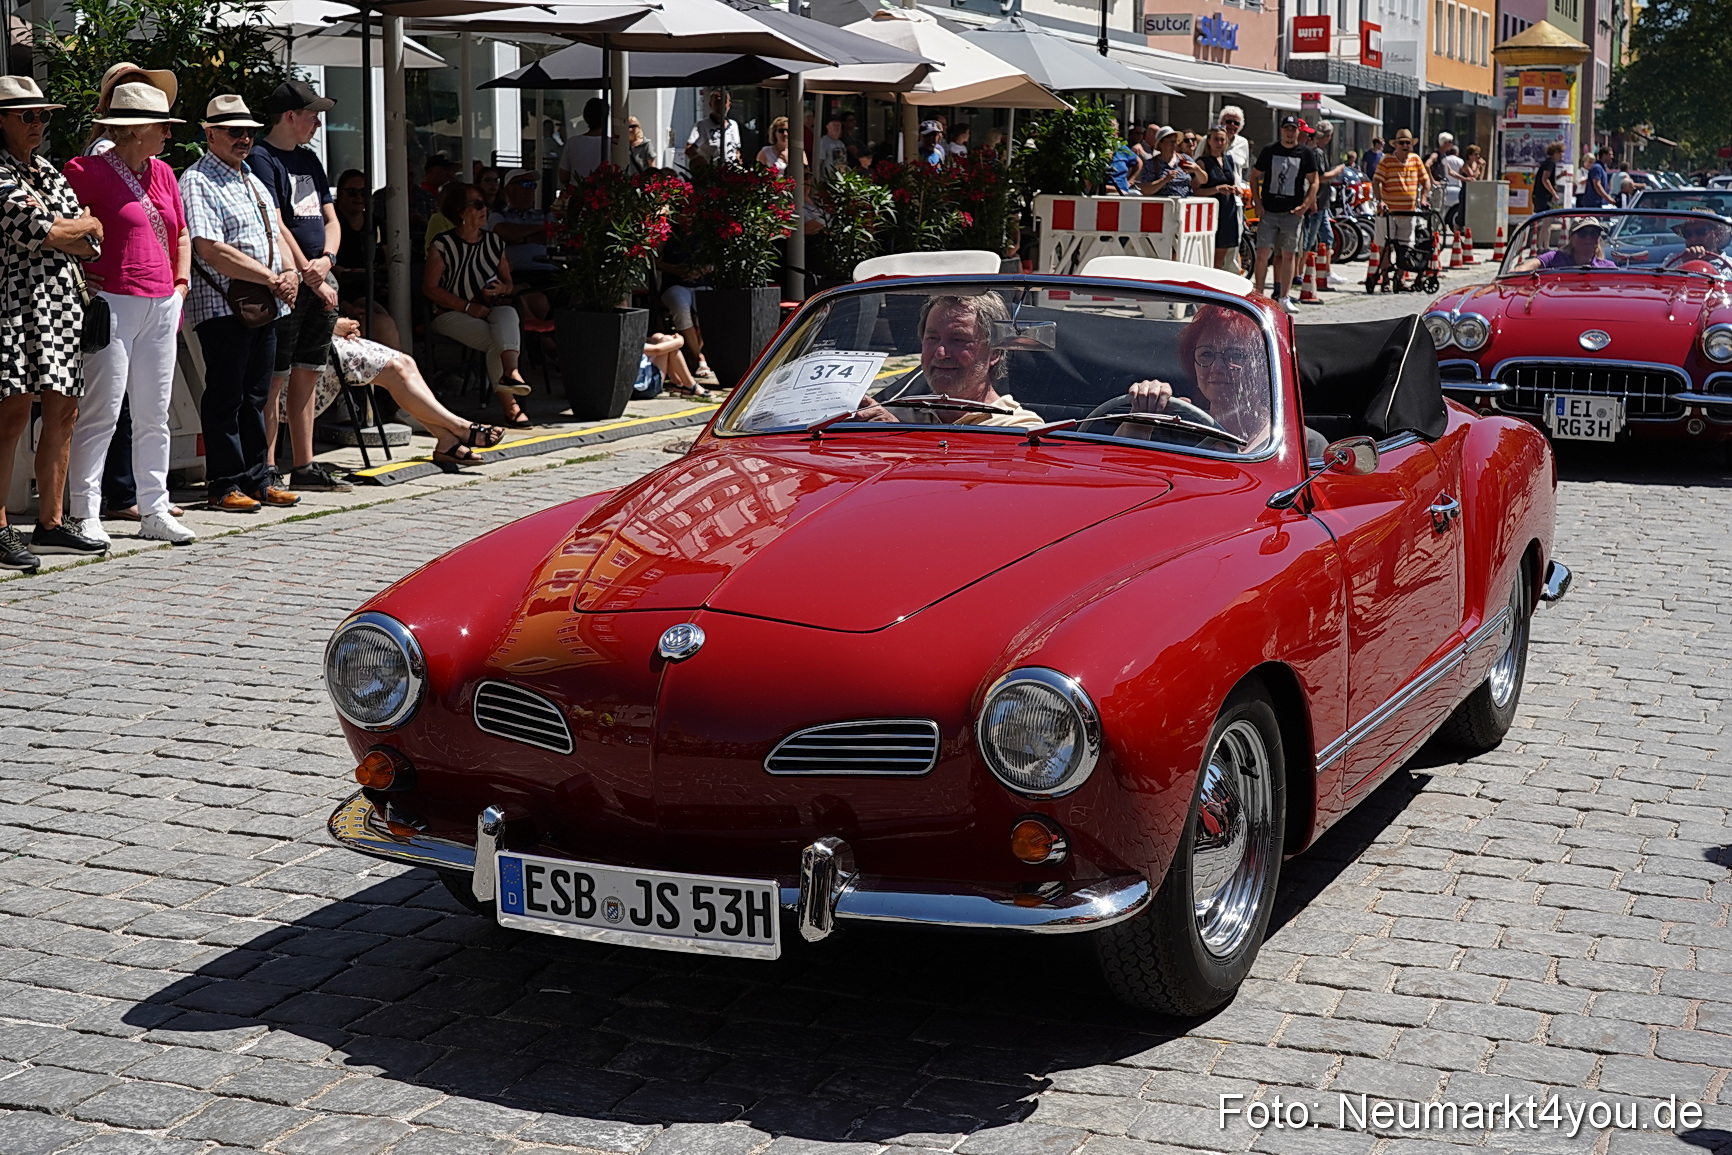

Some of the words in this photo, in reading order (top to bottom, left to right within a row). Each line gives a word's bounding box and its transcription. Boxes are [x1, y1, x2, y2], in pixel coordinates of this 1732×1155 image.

[1297, 27, 1324, 38] WITT
[809, 364, 854, 381] 374
[1570, 400, 1592, 418] EI
[508, 892, 517, 905] D
[525, 865, 597, 919] ESB
[630, 879, 680, 930] JS
[692, 885, 773, 939] 53H
